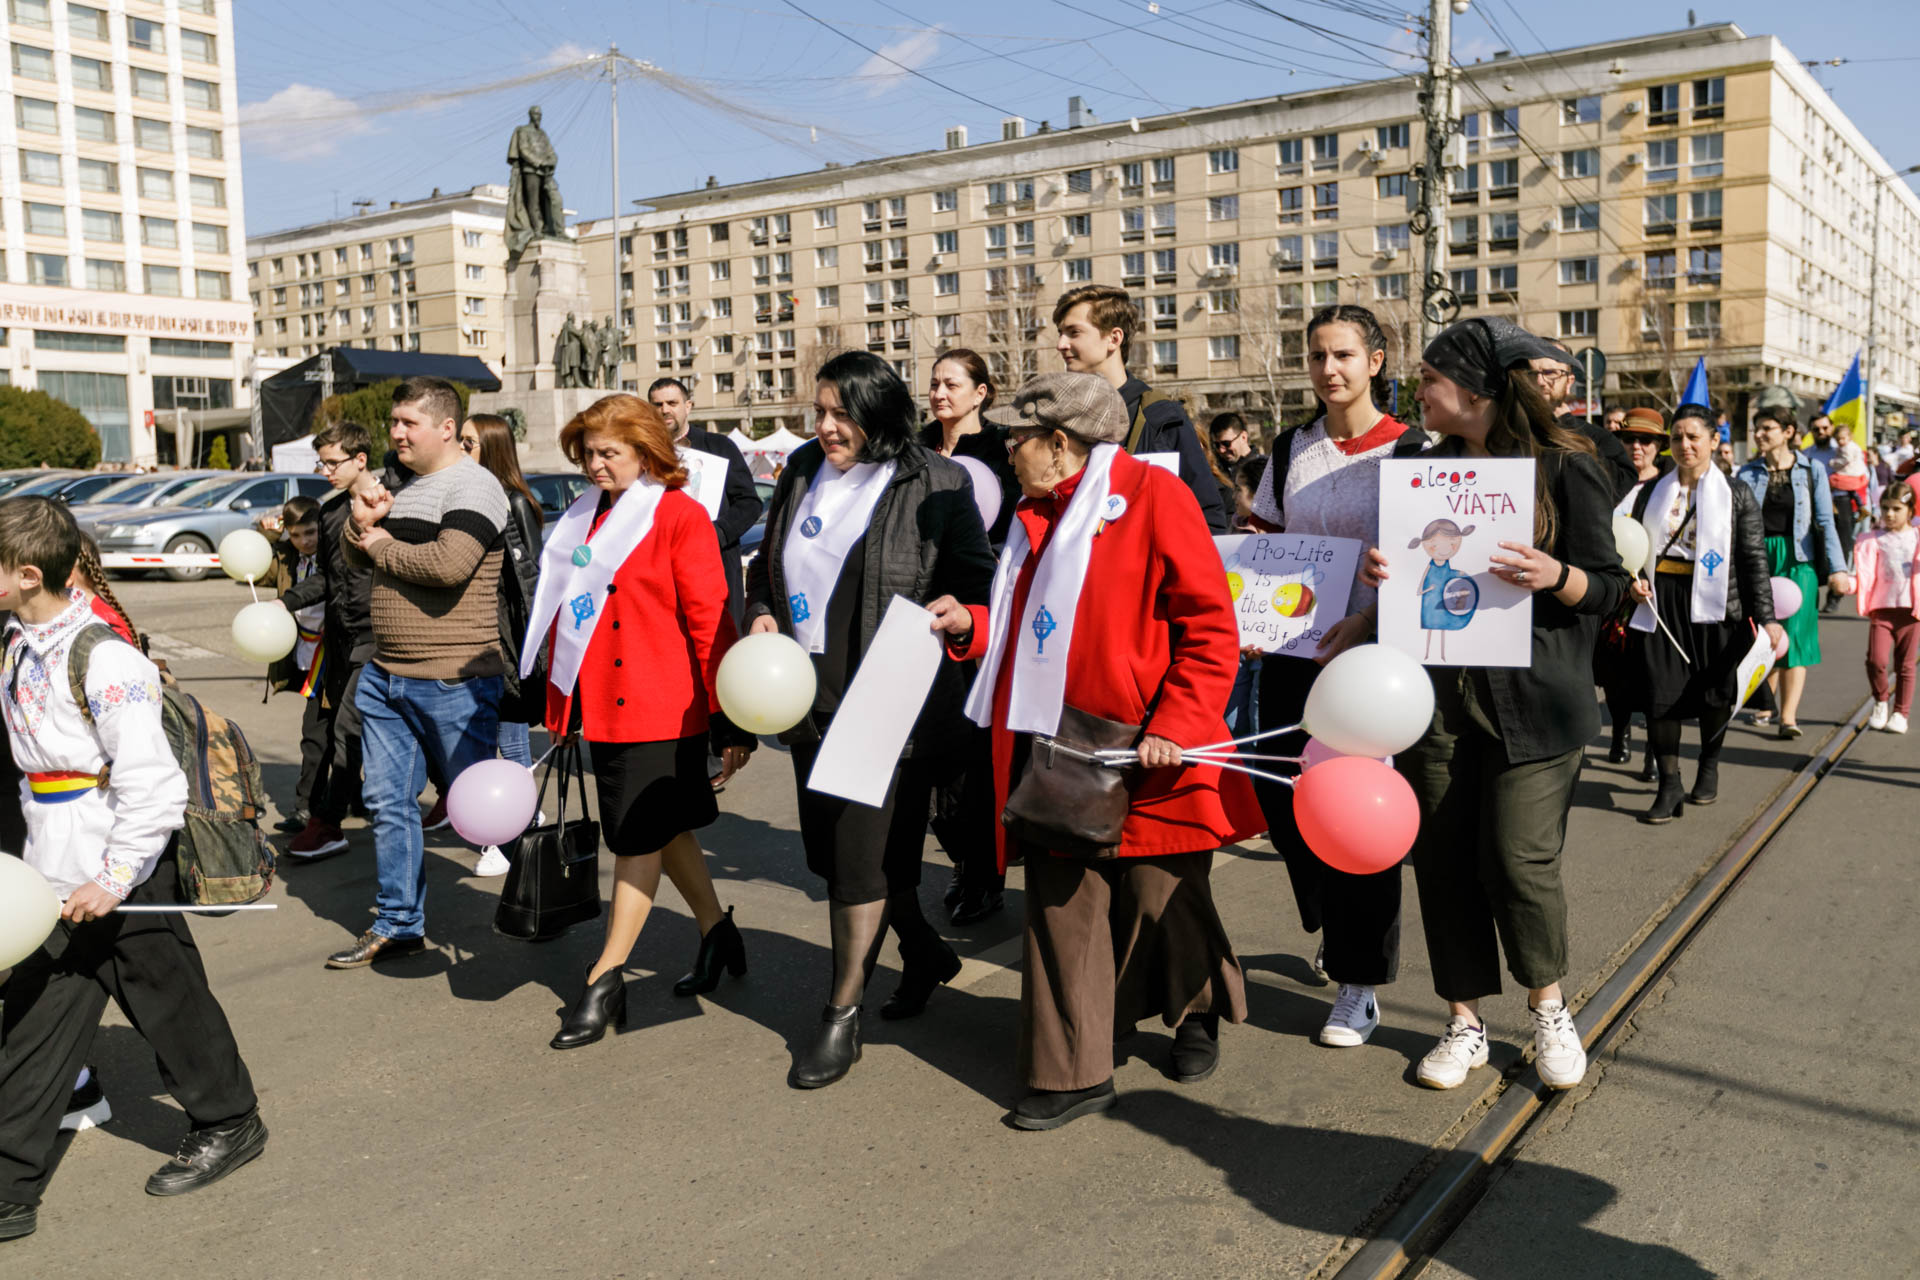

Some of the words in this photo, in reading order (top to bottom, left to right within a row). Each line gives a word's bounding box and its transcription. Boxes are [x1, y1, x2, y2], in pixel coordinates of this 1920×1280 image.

[1411, 466, 1477, 492] alege
[1252, 538, 1334, 563] Pro-Life
[1255, 569, 1272, 587] is
[1241, 593, 1268, 614] the
[1242, 620, 1279, 642] way
[1281, 631, 1298, 650] to
[1301, 621, 1322, 642] be
